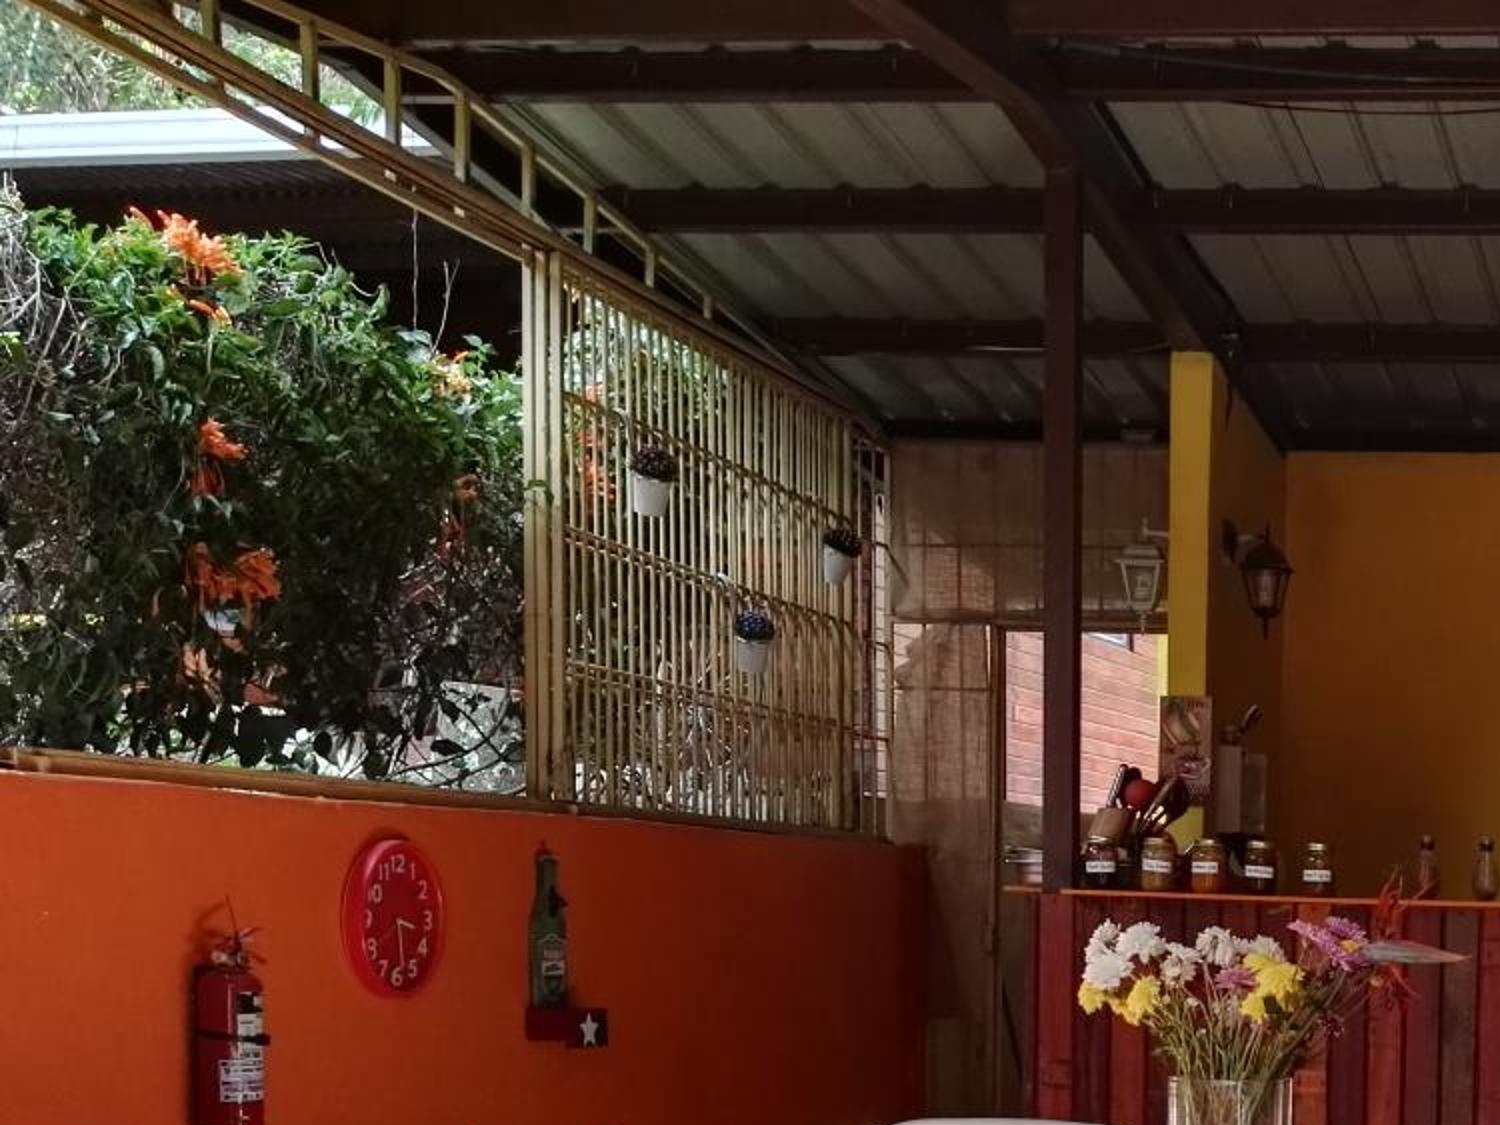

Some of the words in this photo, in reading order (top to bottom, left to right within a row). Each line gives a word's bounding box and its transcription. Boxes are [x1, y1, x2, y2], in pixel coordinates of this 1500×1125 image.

[378, 863, 390, 880] 11
[390, 854, 406, 874] 12
[410, 862, 416, 880] 1
[417, 879, 428, 900] 2
[423, 910, 433, 931] 3
[417, 936, 428, 958] 4
[378, 959, 388, 978] 7
[390, 966, 403, 987] 6
[407, 959, 418, 978] 5
